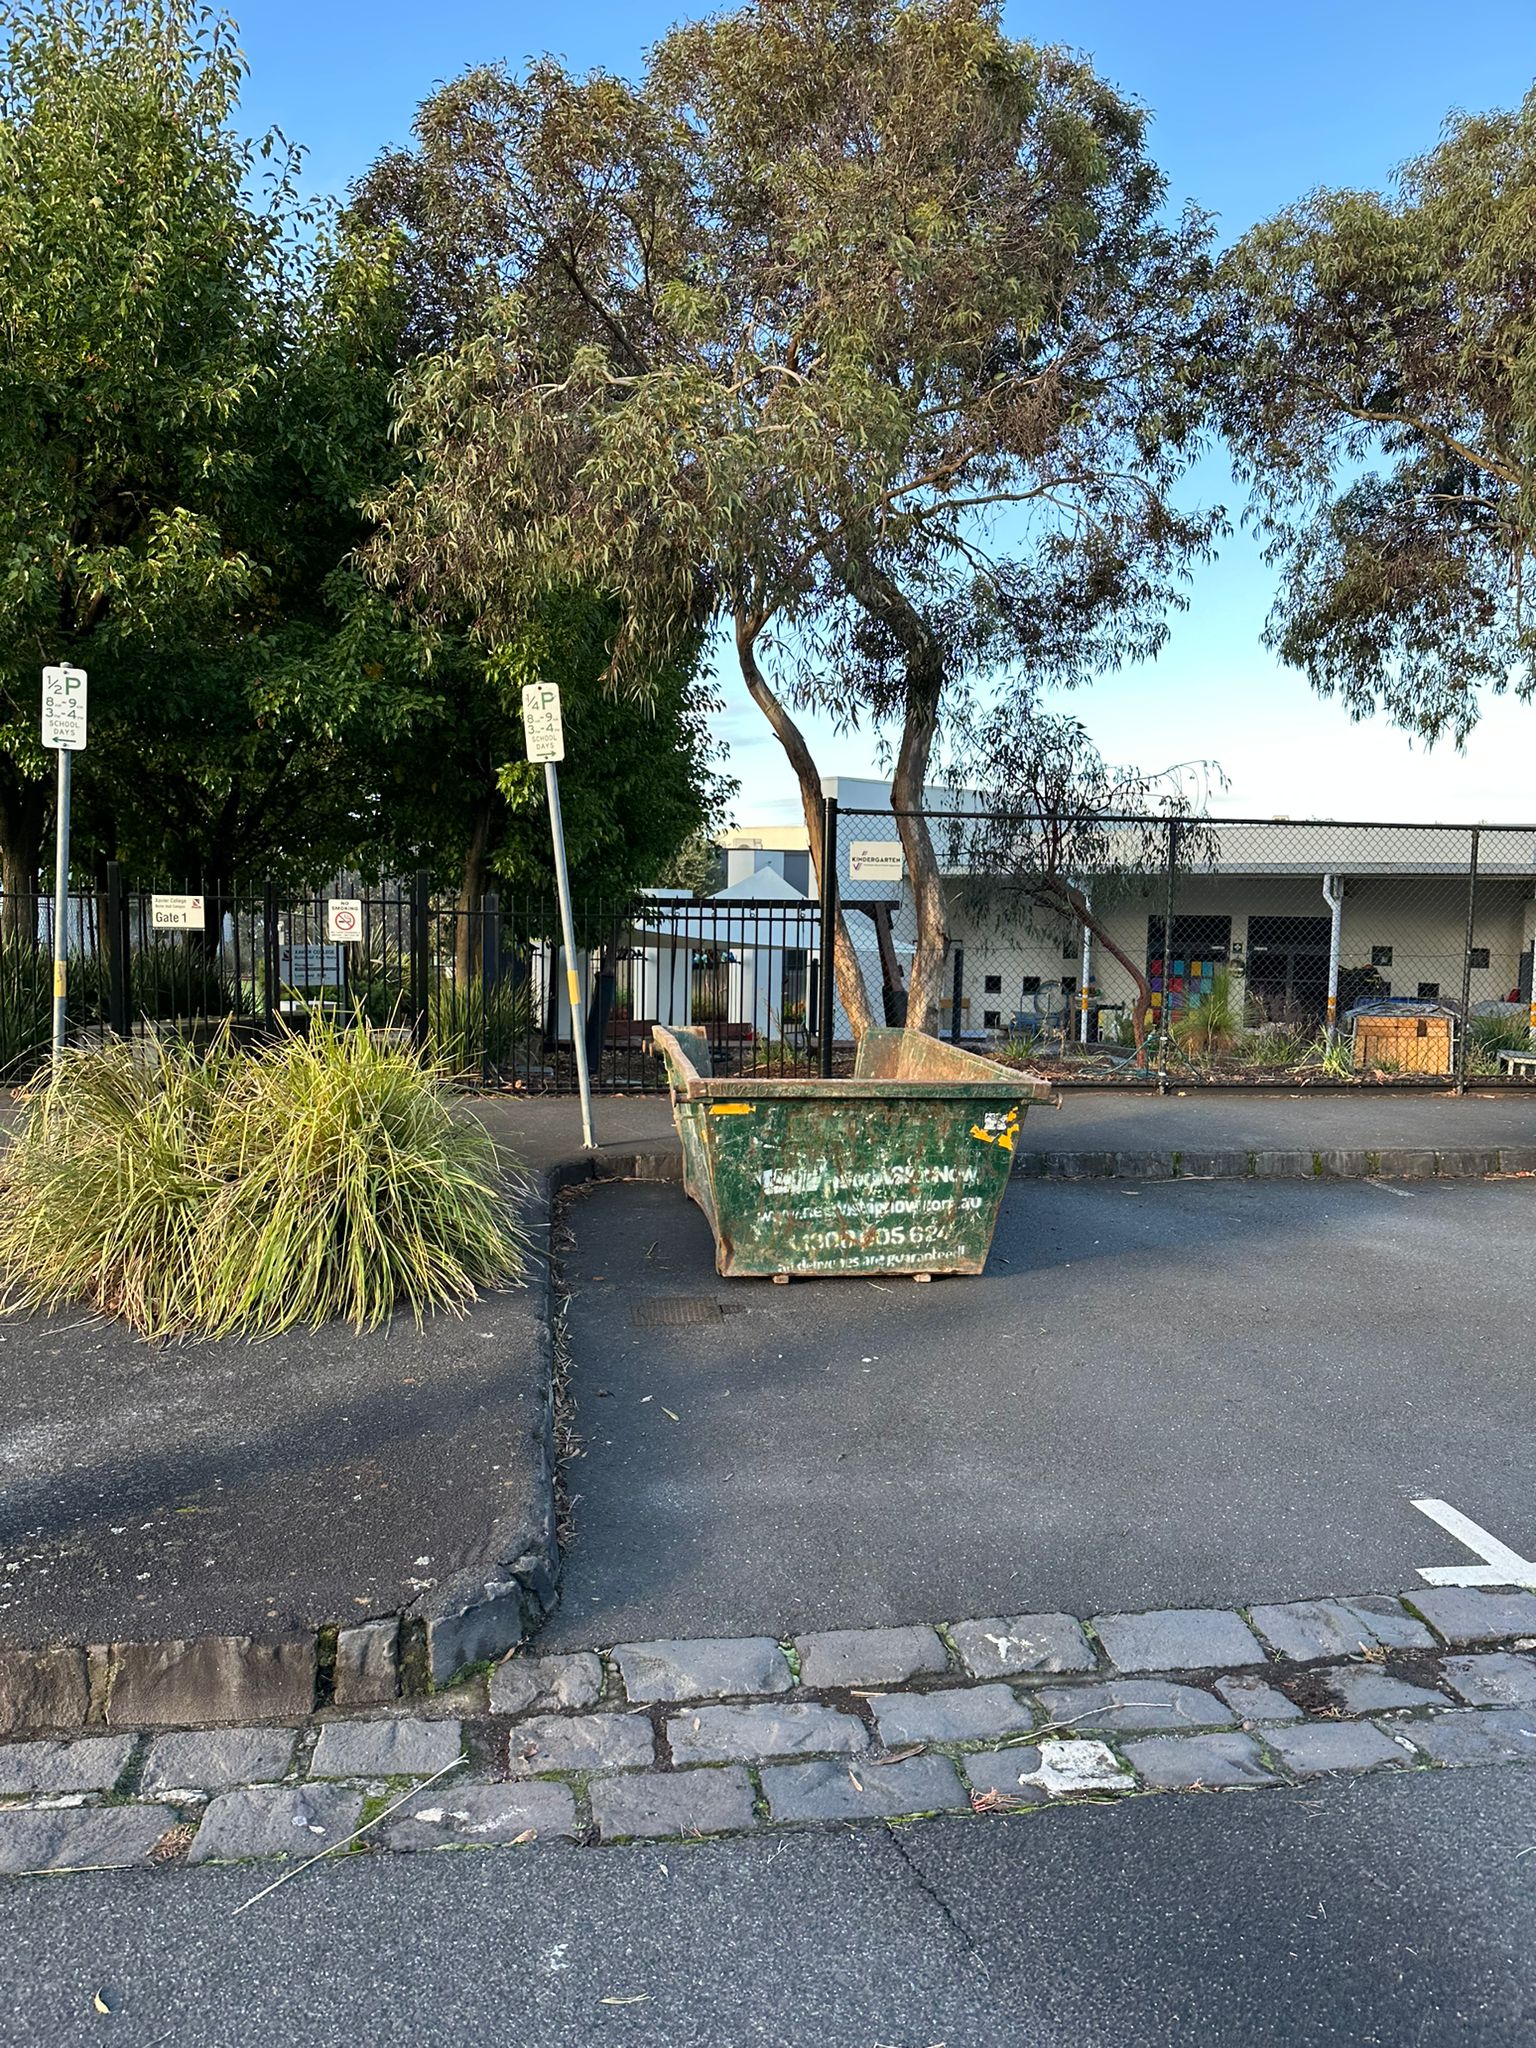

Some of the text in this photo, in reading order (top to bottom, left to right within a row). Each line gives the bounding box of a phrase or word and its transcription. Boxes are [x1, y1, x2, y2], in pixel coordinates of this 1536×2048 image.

[49, 720, 80, 728] SCHOOL
[53, 728, 76, 736] DAYS
[532, 734, 558, 743] SCHOOL
[536, 742, 555, 750] DAYS
[155, 911, 187, 923] Gate 1
